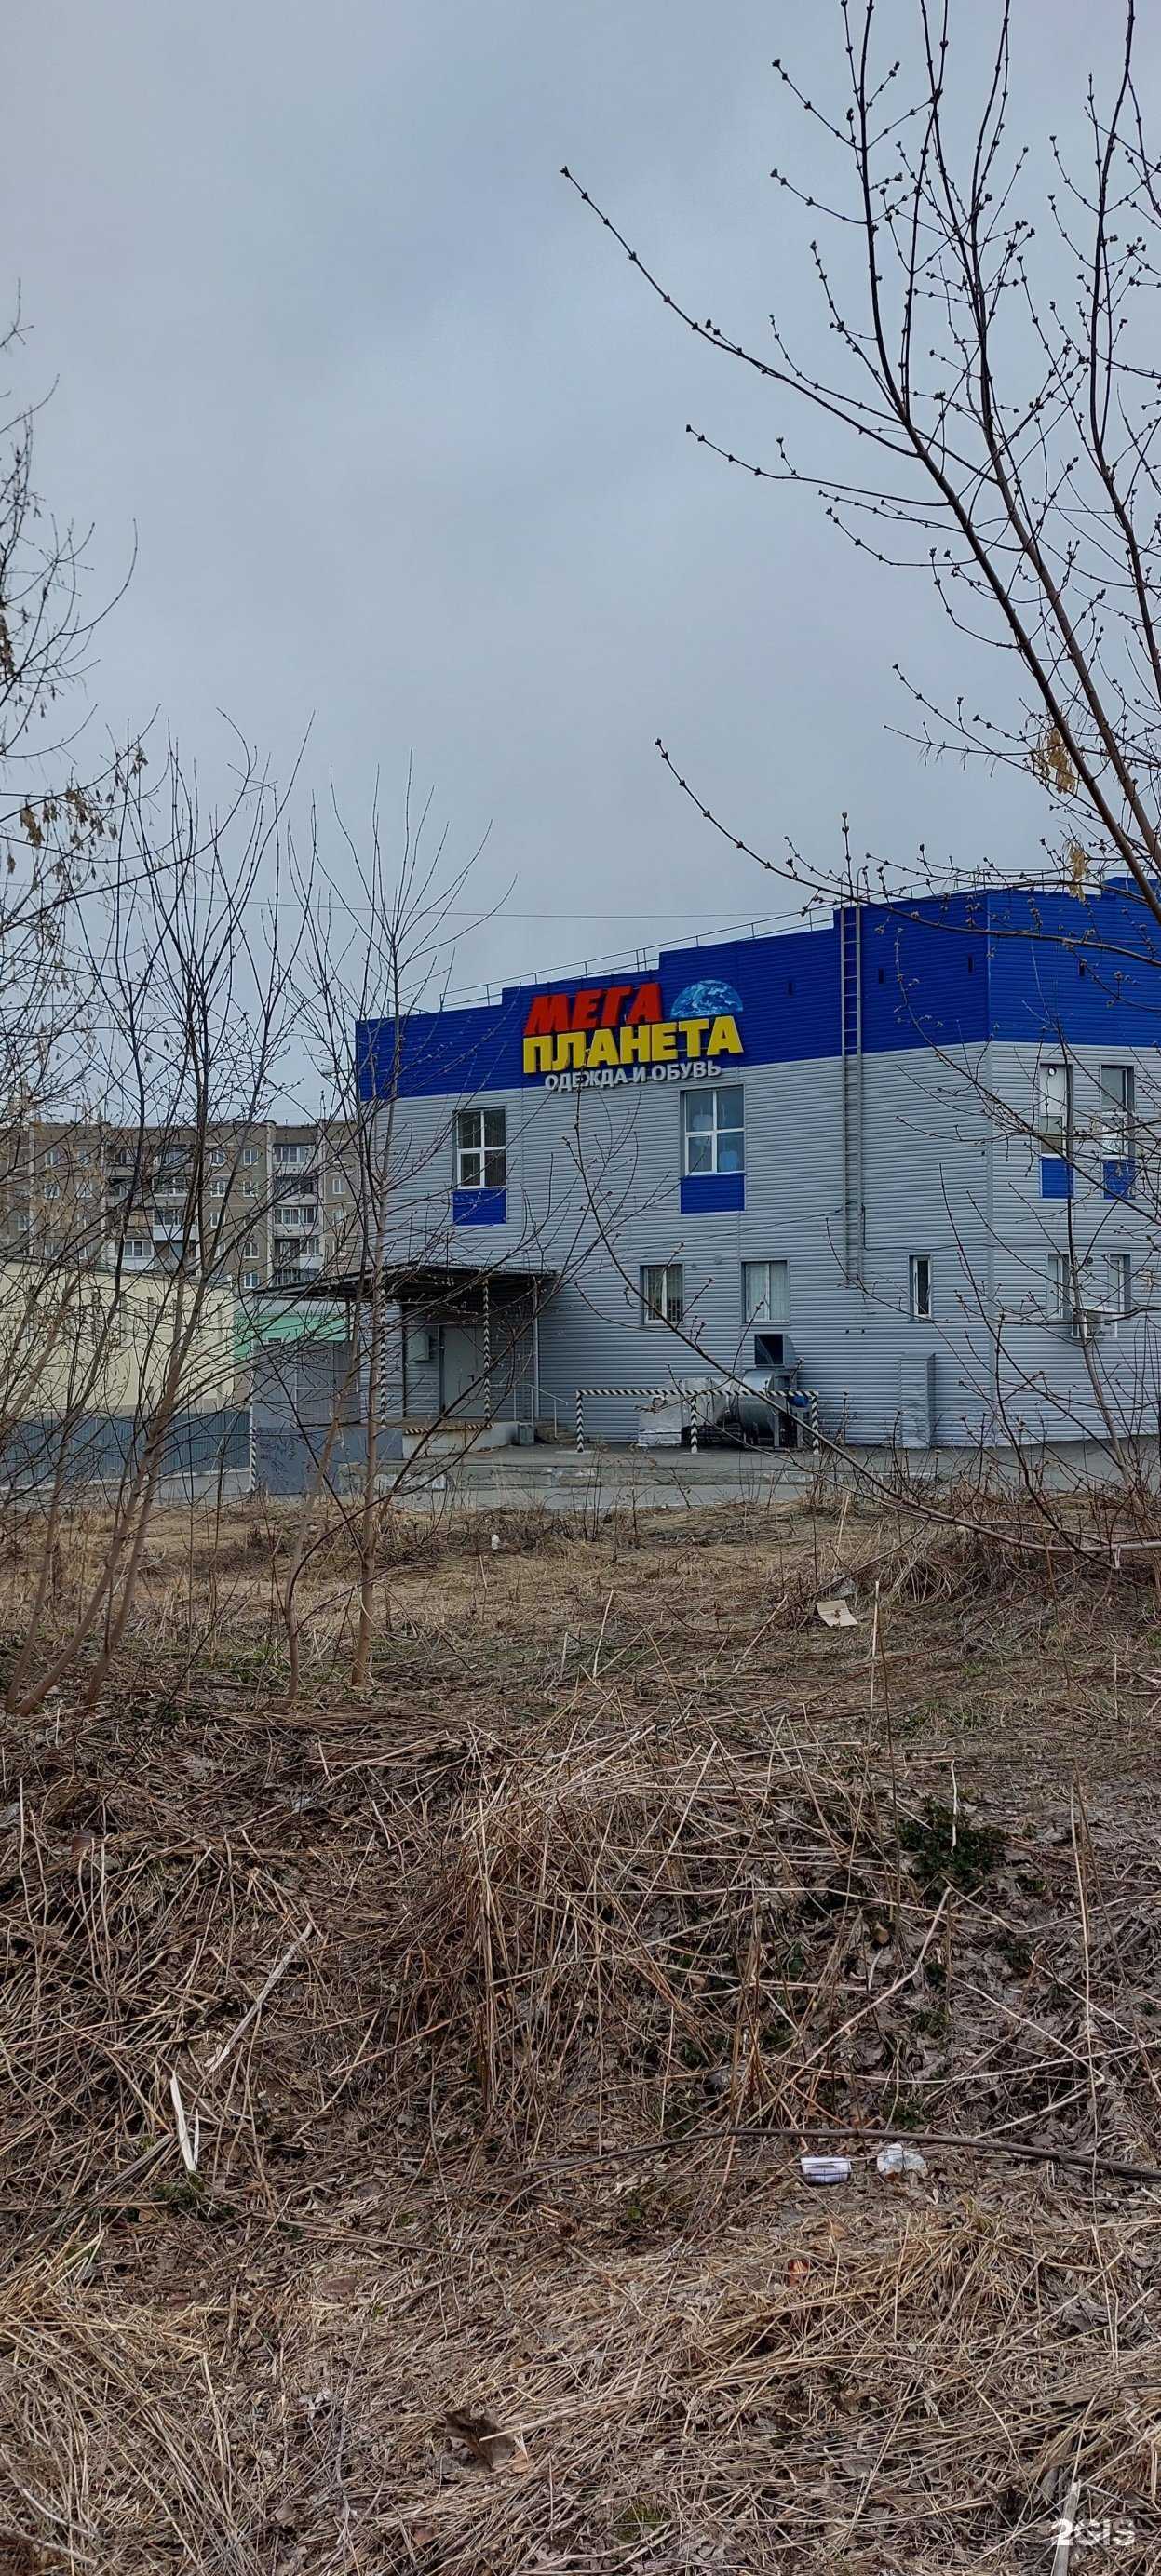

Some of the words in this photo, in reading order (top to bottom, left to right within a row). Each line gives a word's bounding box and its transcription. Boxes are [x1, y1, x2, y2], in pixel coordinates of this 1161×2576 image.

[524, 982, 663, 1036] МЕГА
[523, 1015, 744, 1074] ПЛАНЕТА
[545, 1068, 628, 1093] ОДЕЖДА
[632, 1067, 648, 1083] И
[651, 1060, 722, 1082] ОБУВЬ
